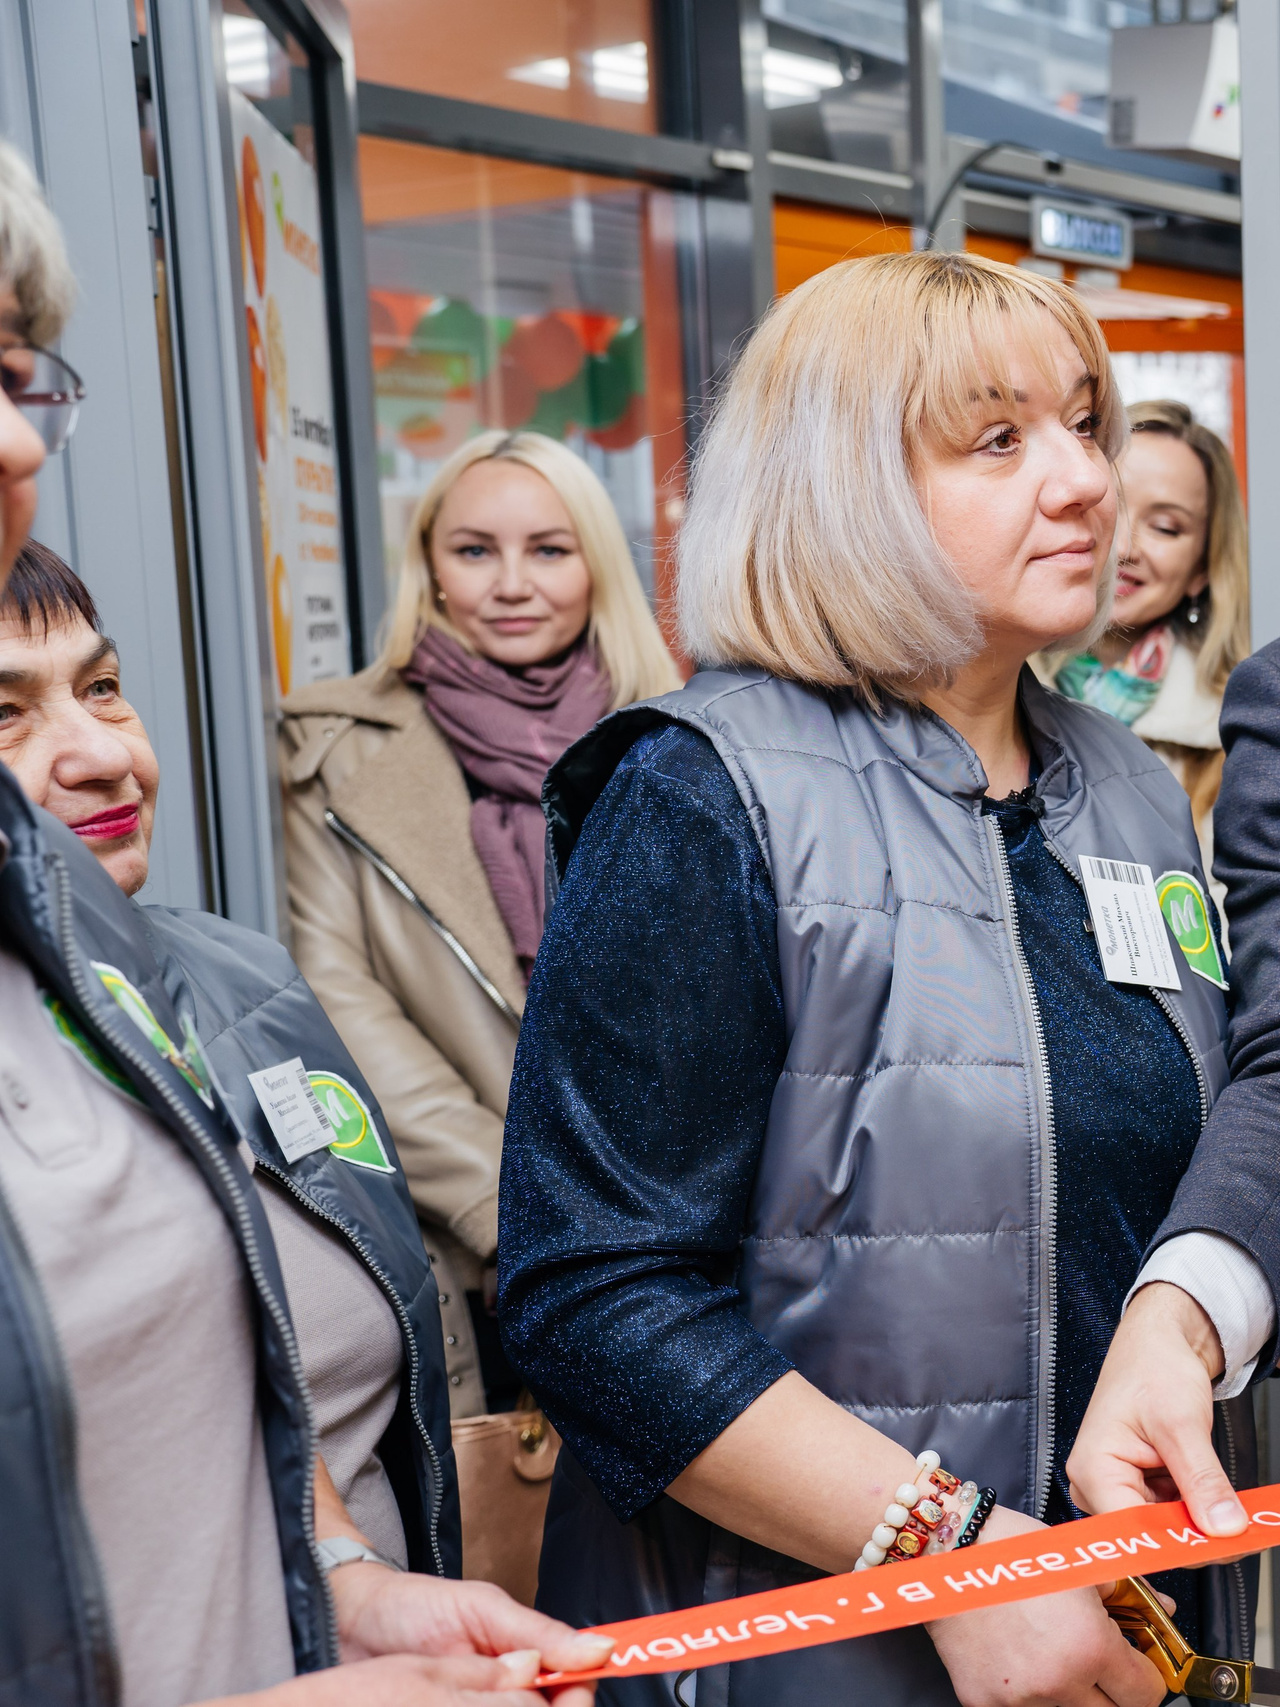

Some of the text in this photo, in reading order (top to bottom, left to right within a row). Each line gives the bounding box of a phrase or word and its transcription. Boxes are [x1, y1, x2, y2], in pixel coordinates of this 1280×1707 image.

[943, 1531, 1162, 1593] магазин
[896, 1581, 936, 1604] в
[609, 1609, 836, 1668] Челяби
